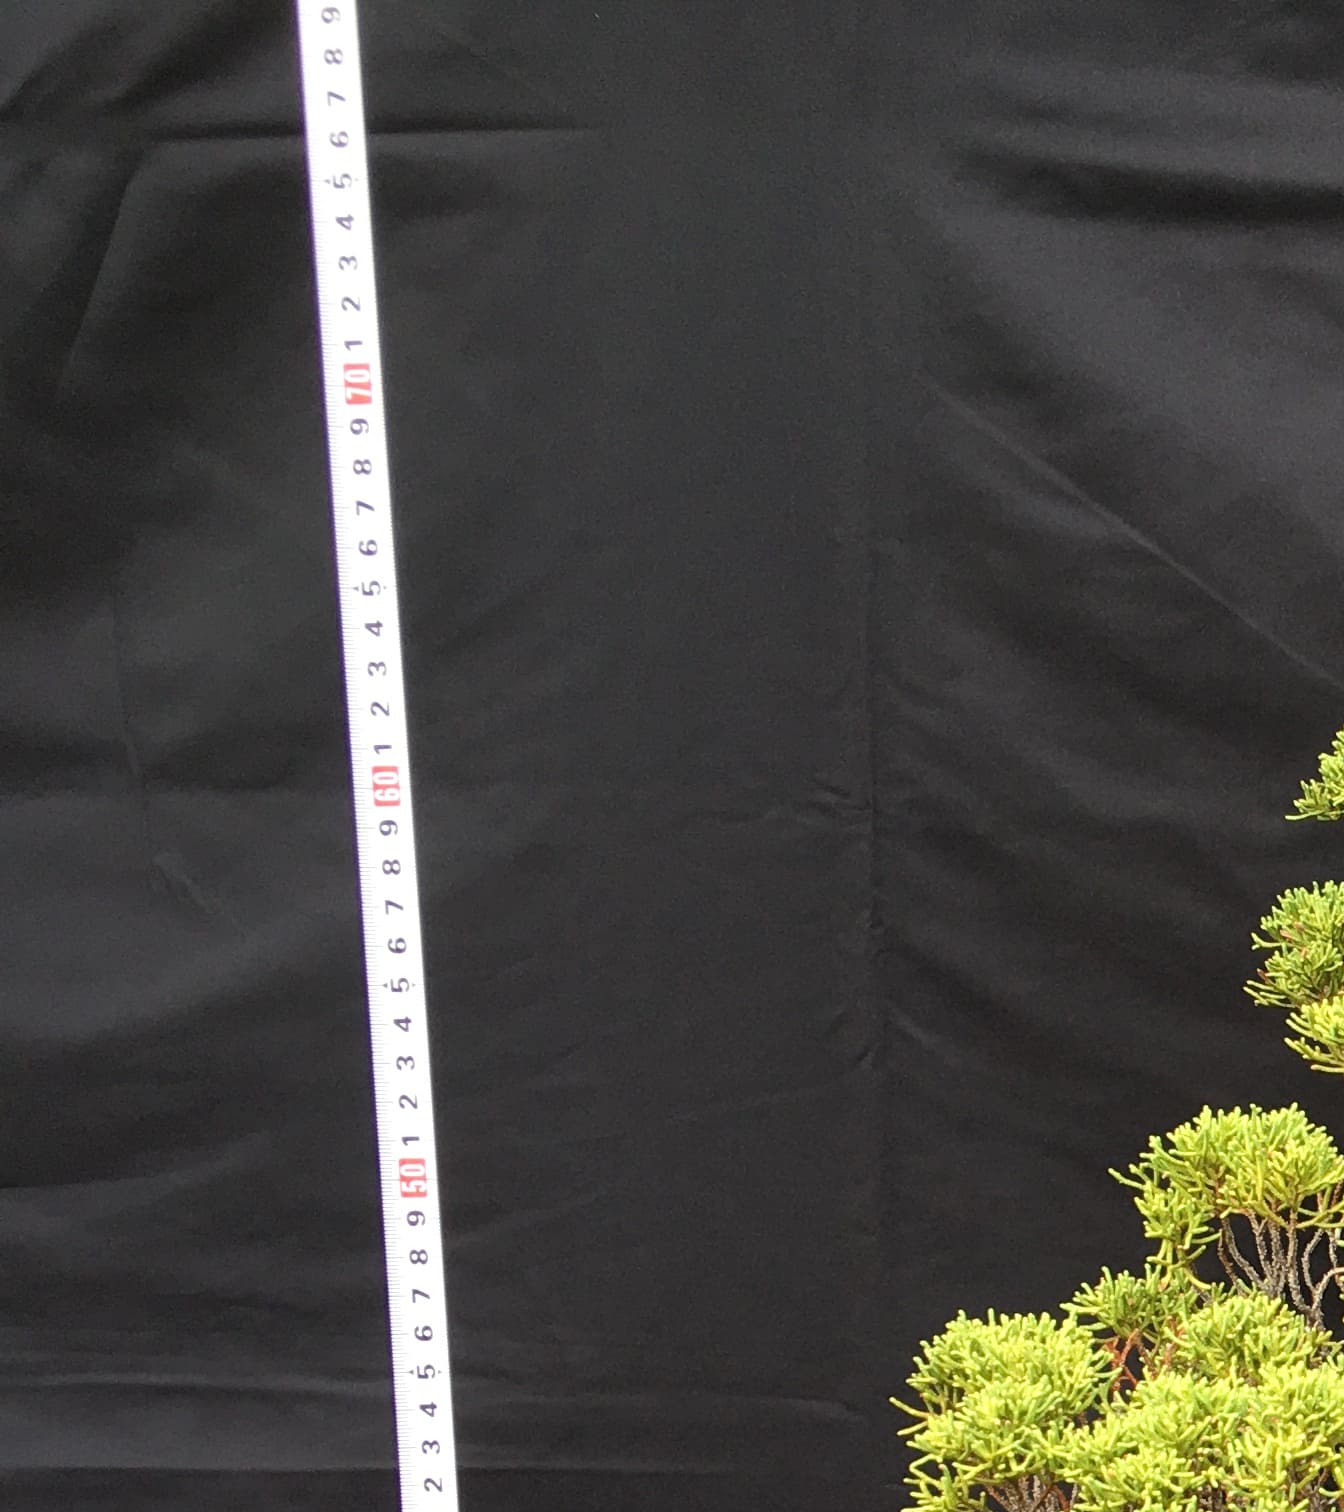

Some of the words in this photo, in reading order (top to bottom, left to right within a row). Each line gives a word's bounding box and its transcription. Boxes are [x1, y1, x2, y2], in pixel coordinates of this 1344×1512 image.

[321, 6, 341, 25] 9
[323, 48, 343, 66] 8
[327, 90, 346, 107] 7
[330, 130, 349, 149] 6
[333, 172, 352, 190] 5
[336, 213, 355, 231] 4
[338, 255, 358, 271] 3
[341, 296, 361, 312] 2
[344, 339, 363, 351] 1
[345, 367, 370, 403] 70
[349, 418, 369, 436] 9
[352, 458, 372, 476] 8
[355, 500, 375, 516] 7
[358, 539, 378, 557] 6
[361, 580, 381, 597] 5
[364, 620, 384, 637] 4
[367, 661, 386, 677] 3
[370, 701, 390, 717] 2
[373, 744, 393, 755] 1
[373, 769, 398, 804] 60
[378, 819, 398, 837] 9
[381, 859, 401, 876] 8
[384, 899, 404, 915] 7
[387, 937, 407, 955] 6
[390, 977, 410, 993] 5
[393, 1016, 412, 1033] 4
[395, 1055, 415, 1071] 3
[398, 1094, 418, 1110] 2
[401, 1136, 420, 1147] 1
[401, 1161, 425, 1196] 50
[406, 1210, 426, 1227] 9
[408, 1248, 429, 1265] 8
[411, 1288, 431, 1304] 7
[414, 1325, 434, 1342] 6
[416, 1364, 436, 1380] 5
[418, 1401, 438, 1418] 4
[421, 1439, 441, 1455] 3
[423, 1477, 443, 1493] 2
